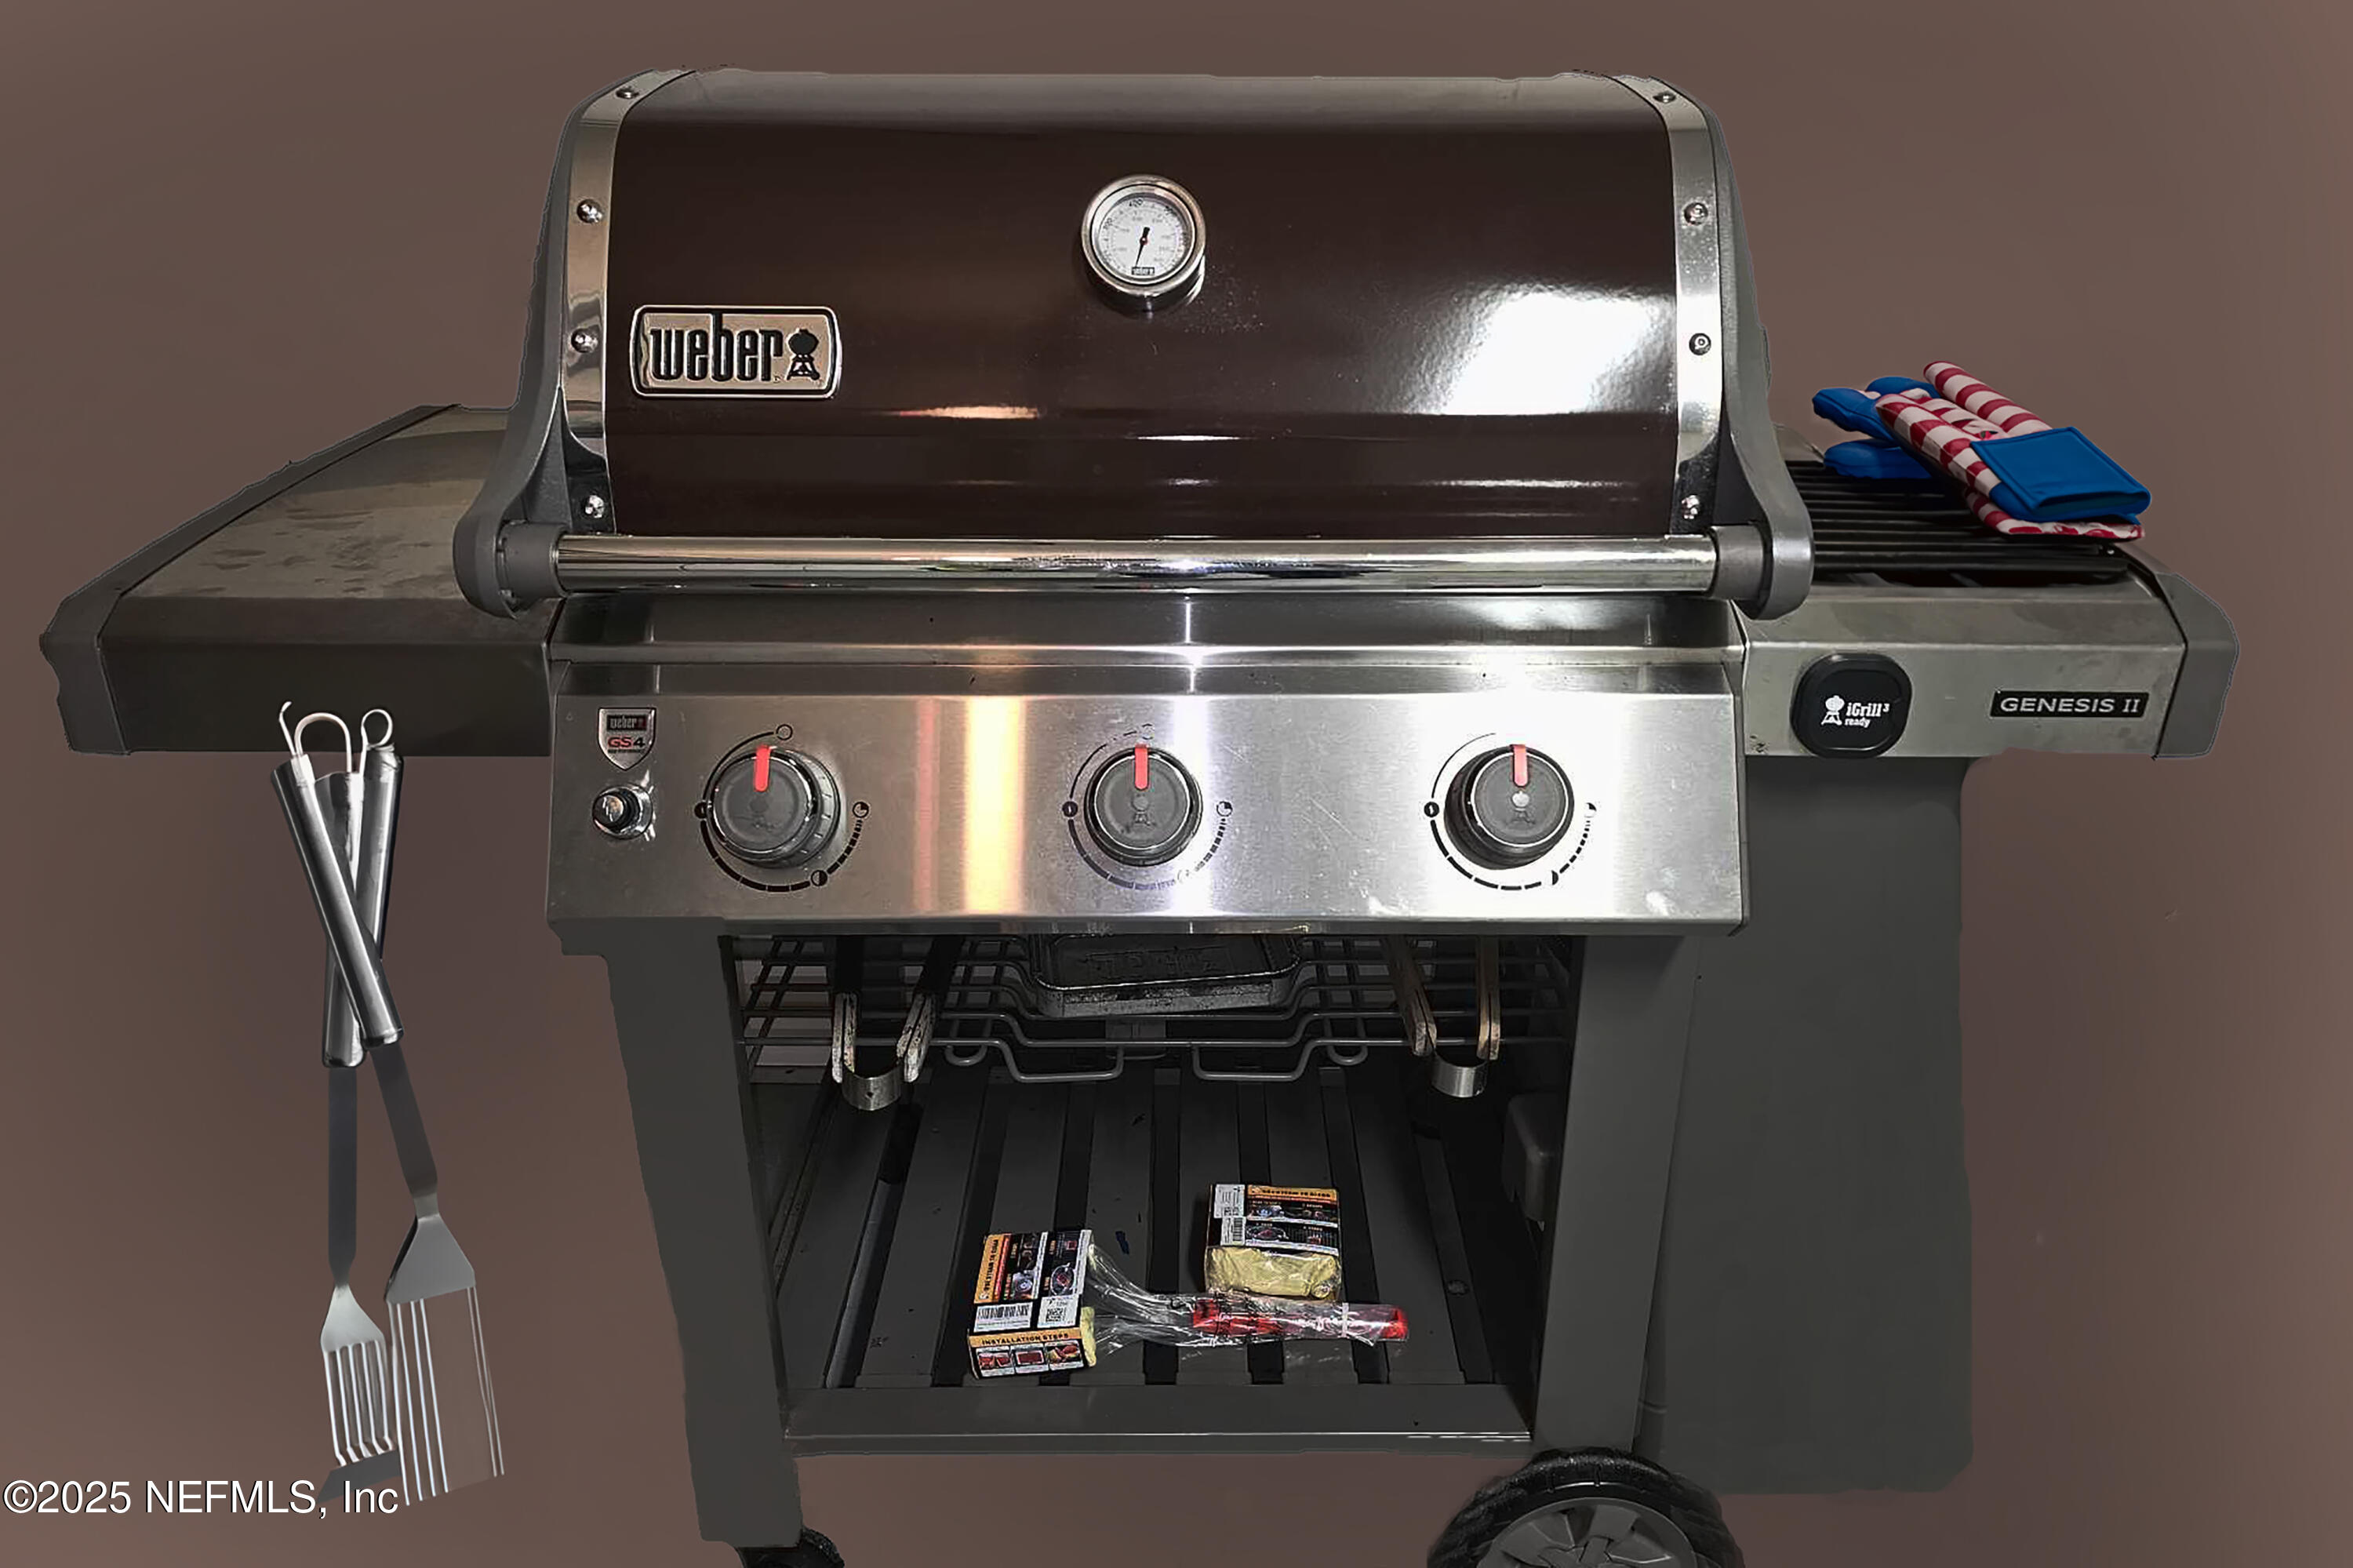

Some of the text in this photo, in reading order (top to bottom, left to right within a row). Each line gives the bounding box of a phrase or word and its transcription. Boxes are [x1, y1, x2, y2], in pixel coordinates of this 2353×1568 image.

[649, 313, 783, 381] weber
[2001, 697, 2140, 712] GENESIS II
[1844, 717, 1871, 728] ready
[608, 737, 645, 748] GS4
[982, 1335, 1042, 1345] INSTALLATION
